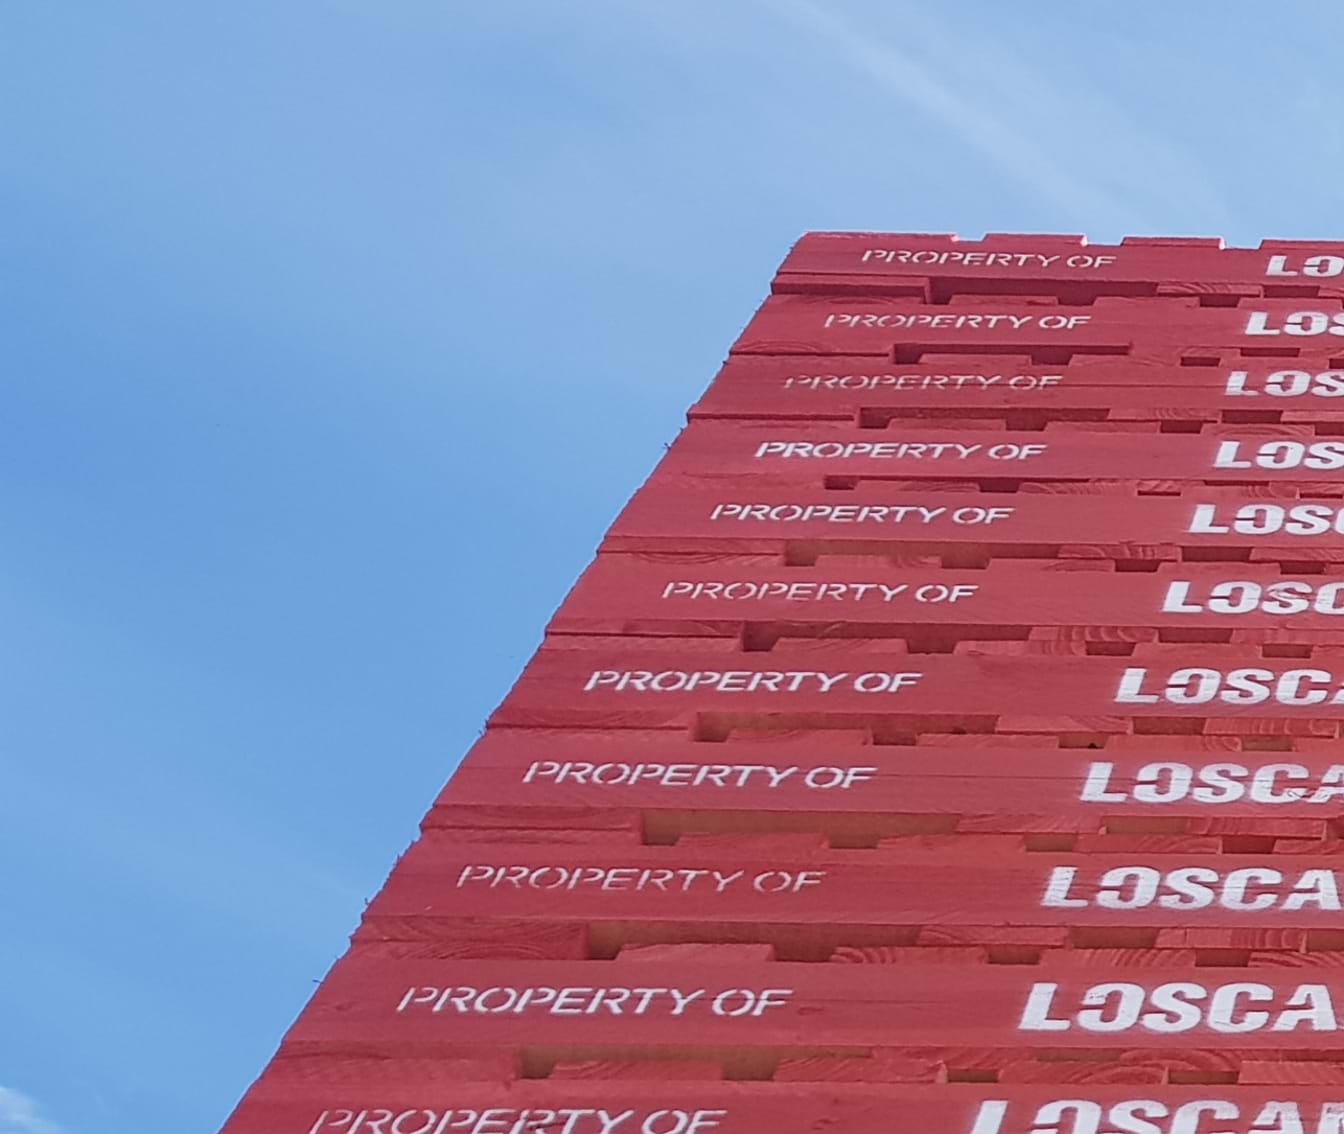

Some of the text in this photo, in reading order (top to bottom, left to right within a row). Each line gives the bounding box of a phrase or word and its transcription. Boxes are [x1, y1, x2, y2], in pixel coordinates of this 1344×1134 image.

[862, 250, 1060, 267] PROPERTY
[1067, 256, 1116, 268] OF
[825, 315, 1032, 328] PROPERTY
[1039, 316, 1091, 328] OF
[784, 376, 1001, 389] PROPERTY
[1009, 376, 1063, 389] OF
[755, 443, 981, 458] PROPERTY
[988, 445, 1046, 459] OF
[711, 505, 946, 522] PROPERTY
[953, 508, 1014, 523] OF
[663, 583, 908, 601] PROPERTY
[915, 585, 978, 602] OF
[584, 671, 848, 691] PROPERTY
[854, 673, 922, 692] OF
[523, 762, 798, 787] PROPERTY
[805, 767, 877, 788] OF
[457, 866, 744, 891] PROPERTY
[754, 872, 825, 891] OF
[397, 987, 705, 1014] PROPERTY
[712, 990, 792, 1016] OF
